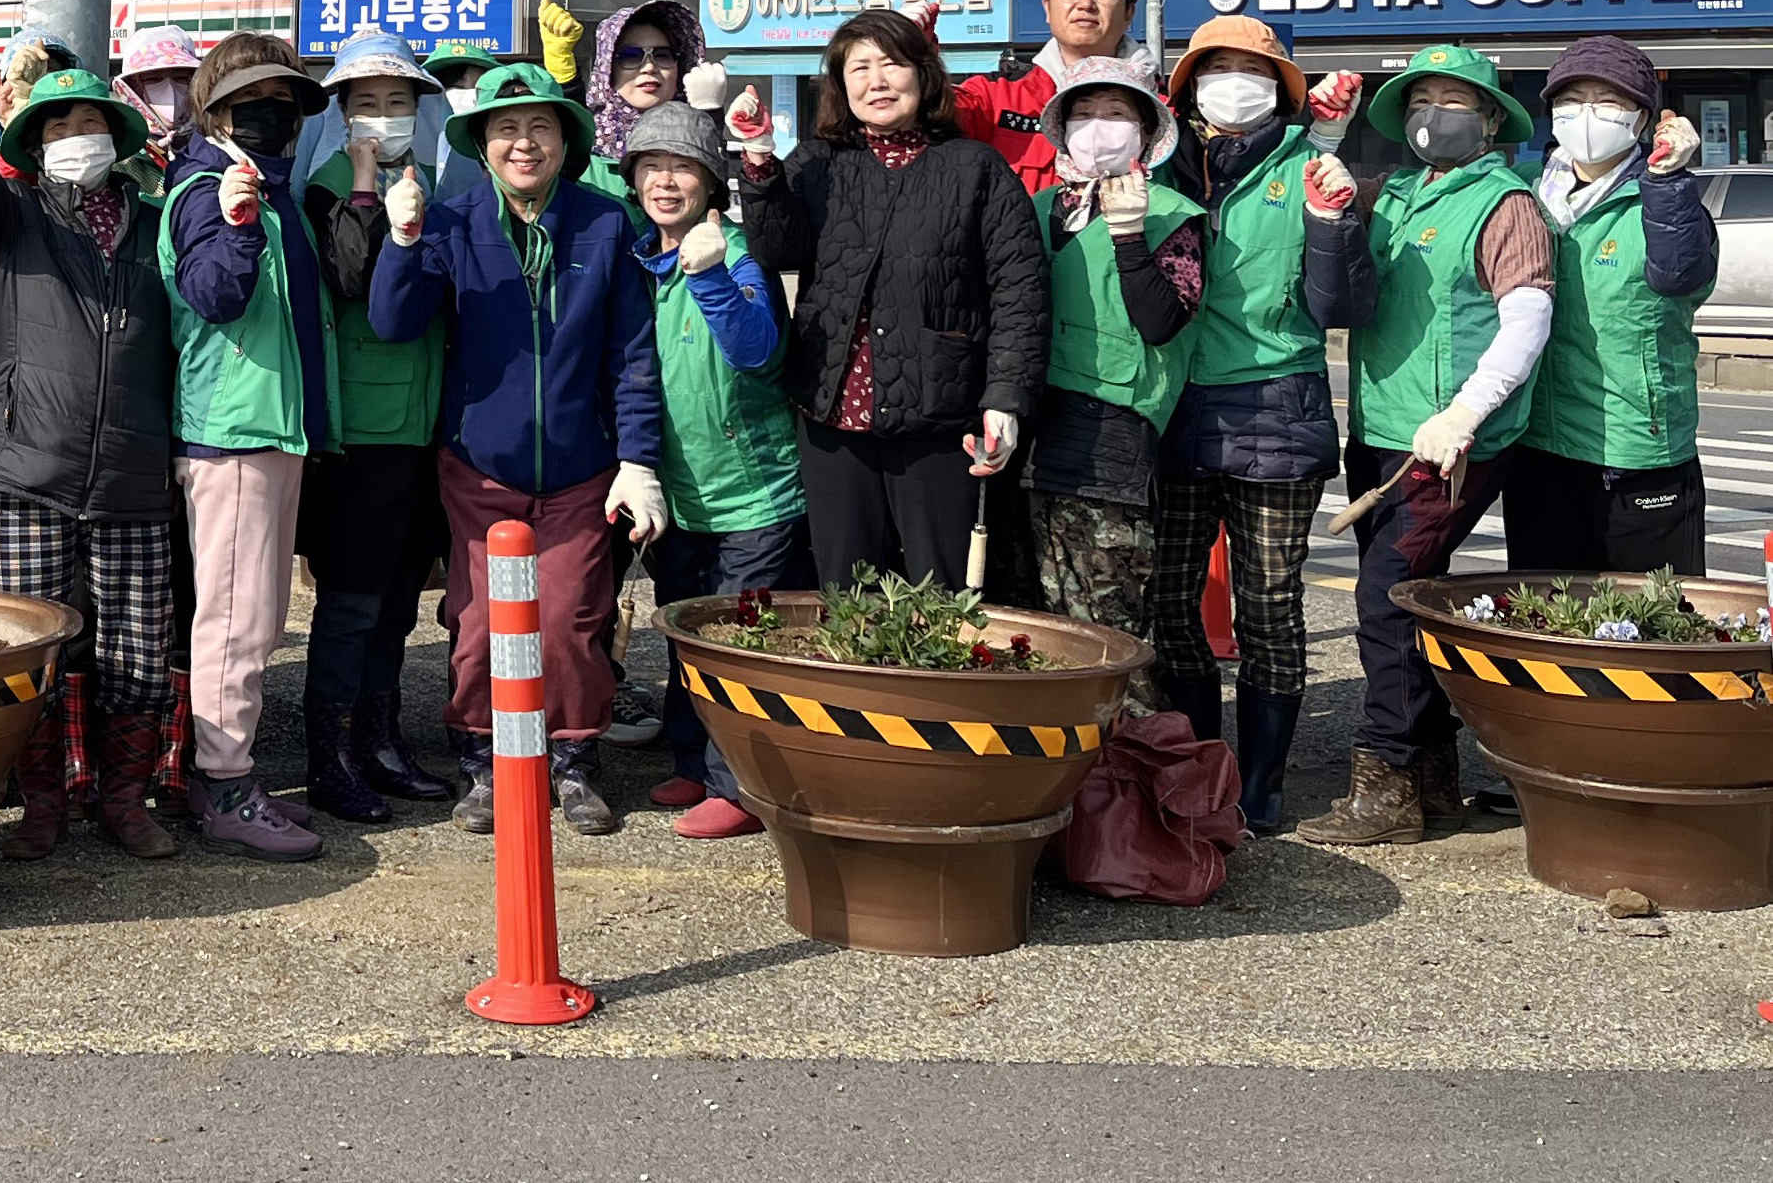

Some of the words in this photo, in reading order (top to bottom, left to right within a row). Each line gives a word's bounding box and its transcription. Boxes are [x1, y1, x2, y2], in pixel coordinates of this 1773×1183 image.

[812, 28, 838, 39] Crea
[1594, 258, 1618, 268] SMU
[1635, 497, 1660, 506] Calvin
[1660, 494, 1677, 503] Klein
